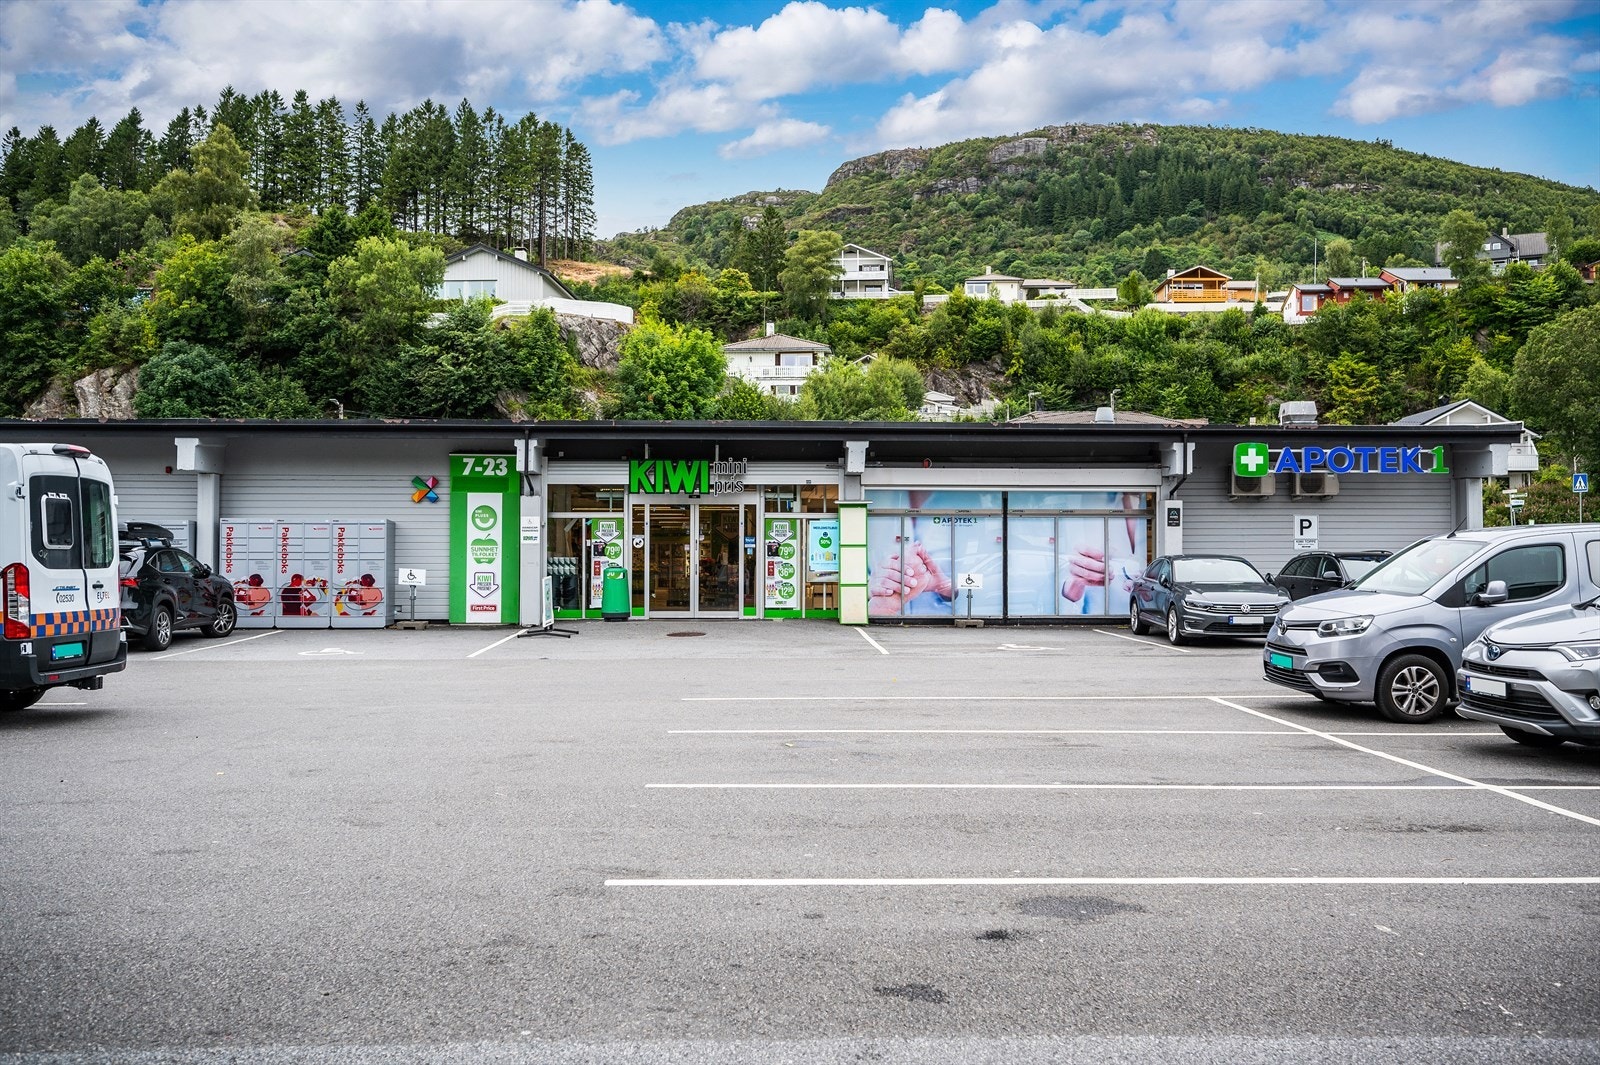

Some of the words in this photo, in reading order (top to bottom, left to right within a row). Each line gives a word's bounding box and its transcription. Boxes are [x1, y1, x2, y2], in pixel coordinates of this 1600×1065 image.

[462, 457, 508, 476] 7-23
[1275, 446, 1424, 474] APOTEK
[1429, 446, 1450, 474] 1
[629, 459, 710, 494] KIWI
[713, 457, 747, 475] mini
[713, 476, 744, 497] pris
[1300, 519, 1312, 536] P
[225, 526, 234, 574] Pakkeboks
[281, 527, 290, 574] Pakkeboks
[336, 527, 346, 574] Pakkeboks
[59, 594, 75, 603] 02530
